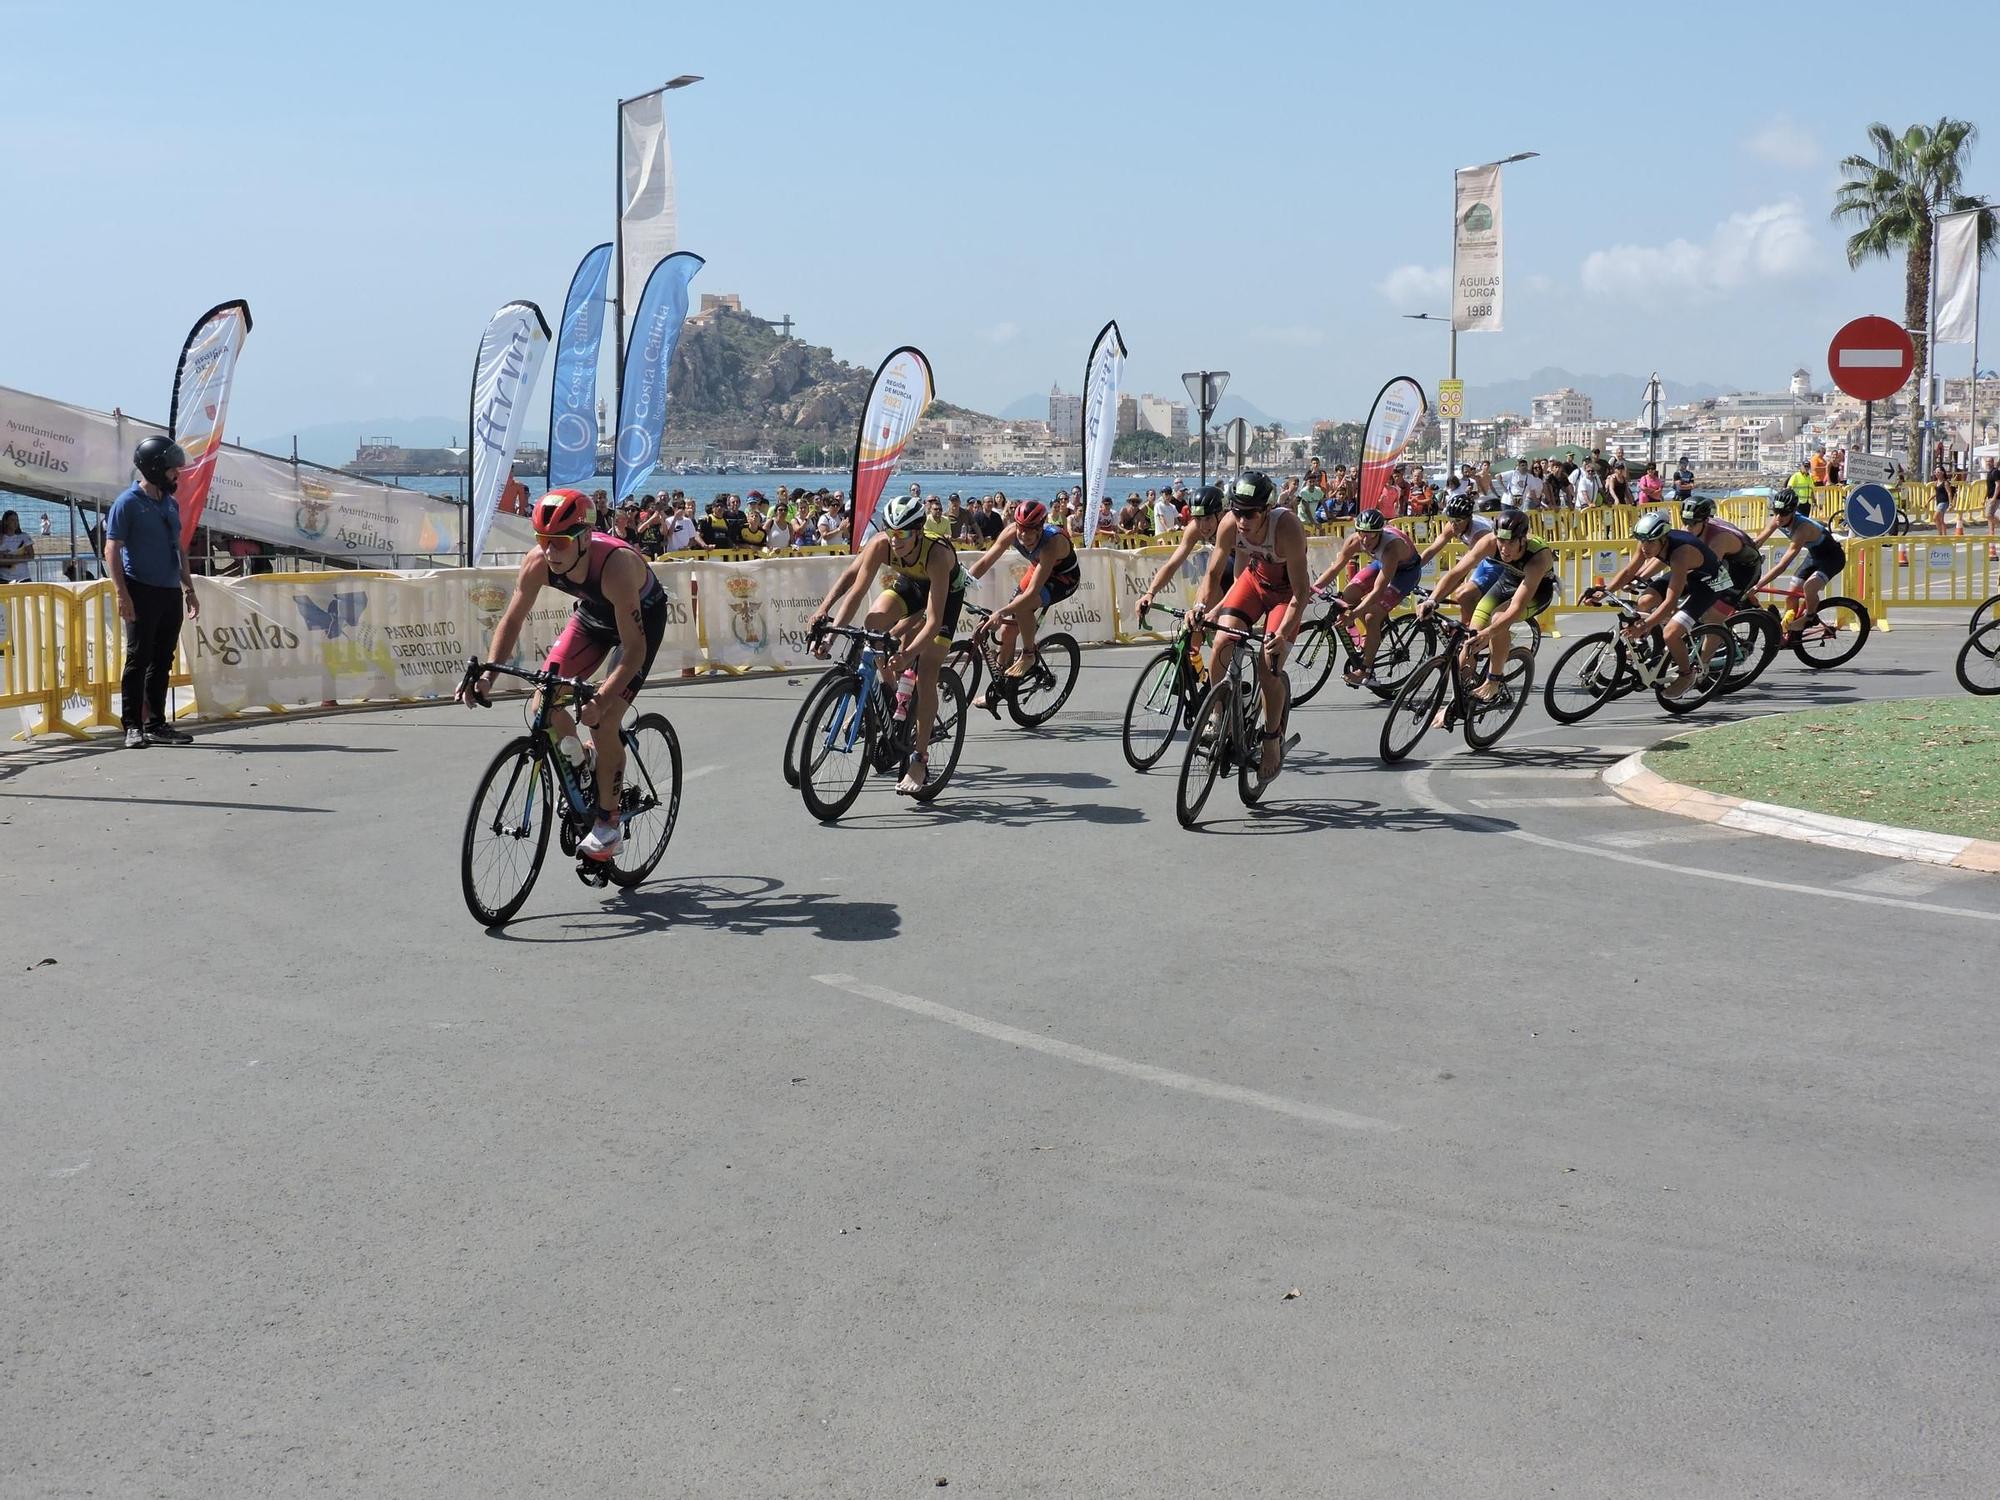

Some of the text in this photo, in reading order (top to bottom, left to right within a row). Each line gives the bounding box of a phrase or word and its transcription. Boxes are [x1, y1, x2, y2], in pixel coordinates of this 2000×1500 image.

[1460, 275, 1500, 287] ÁGUILAS
[1464, 288, 1496, 297] LORCA
[1466, 305, 1493, 317] 1988
[634, 304, 670, 419] Costa Cálida
[886, 379, 906, 390] REGIÓN
[892, 388, 912, 400] MURCIA
[7, 420, 75, 445] Ayuntamiento
[32, 439, 46, 450] de
[2, 441, 70, 473] Águilas
[338, 505, 400, 526] Ayuntamiento
[361, 523, 373, 532] de
[335, 526, 395, 551] Águilas
[770, 597, 824, 614] Ayuntamient
[384, 621, 456, 639] PATRONATO
[392, 640, 462, 658] DEPORTIVO
[400, 660, 468, 677] MUNICIPAL
